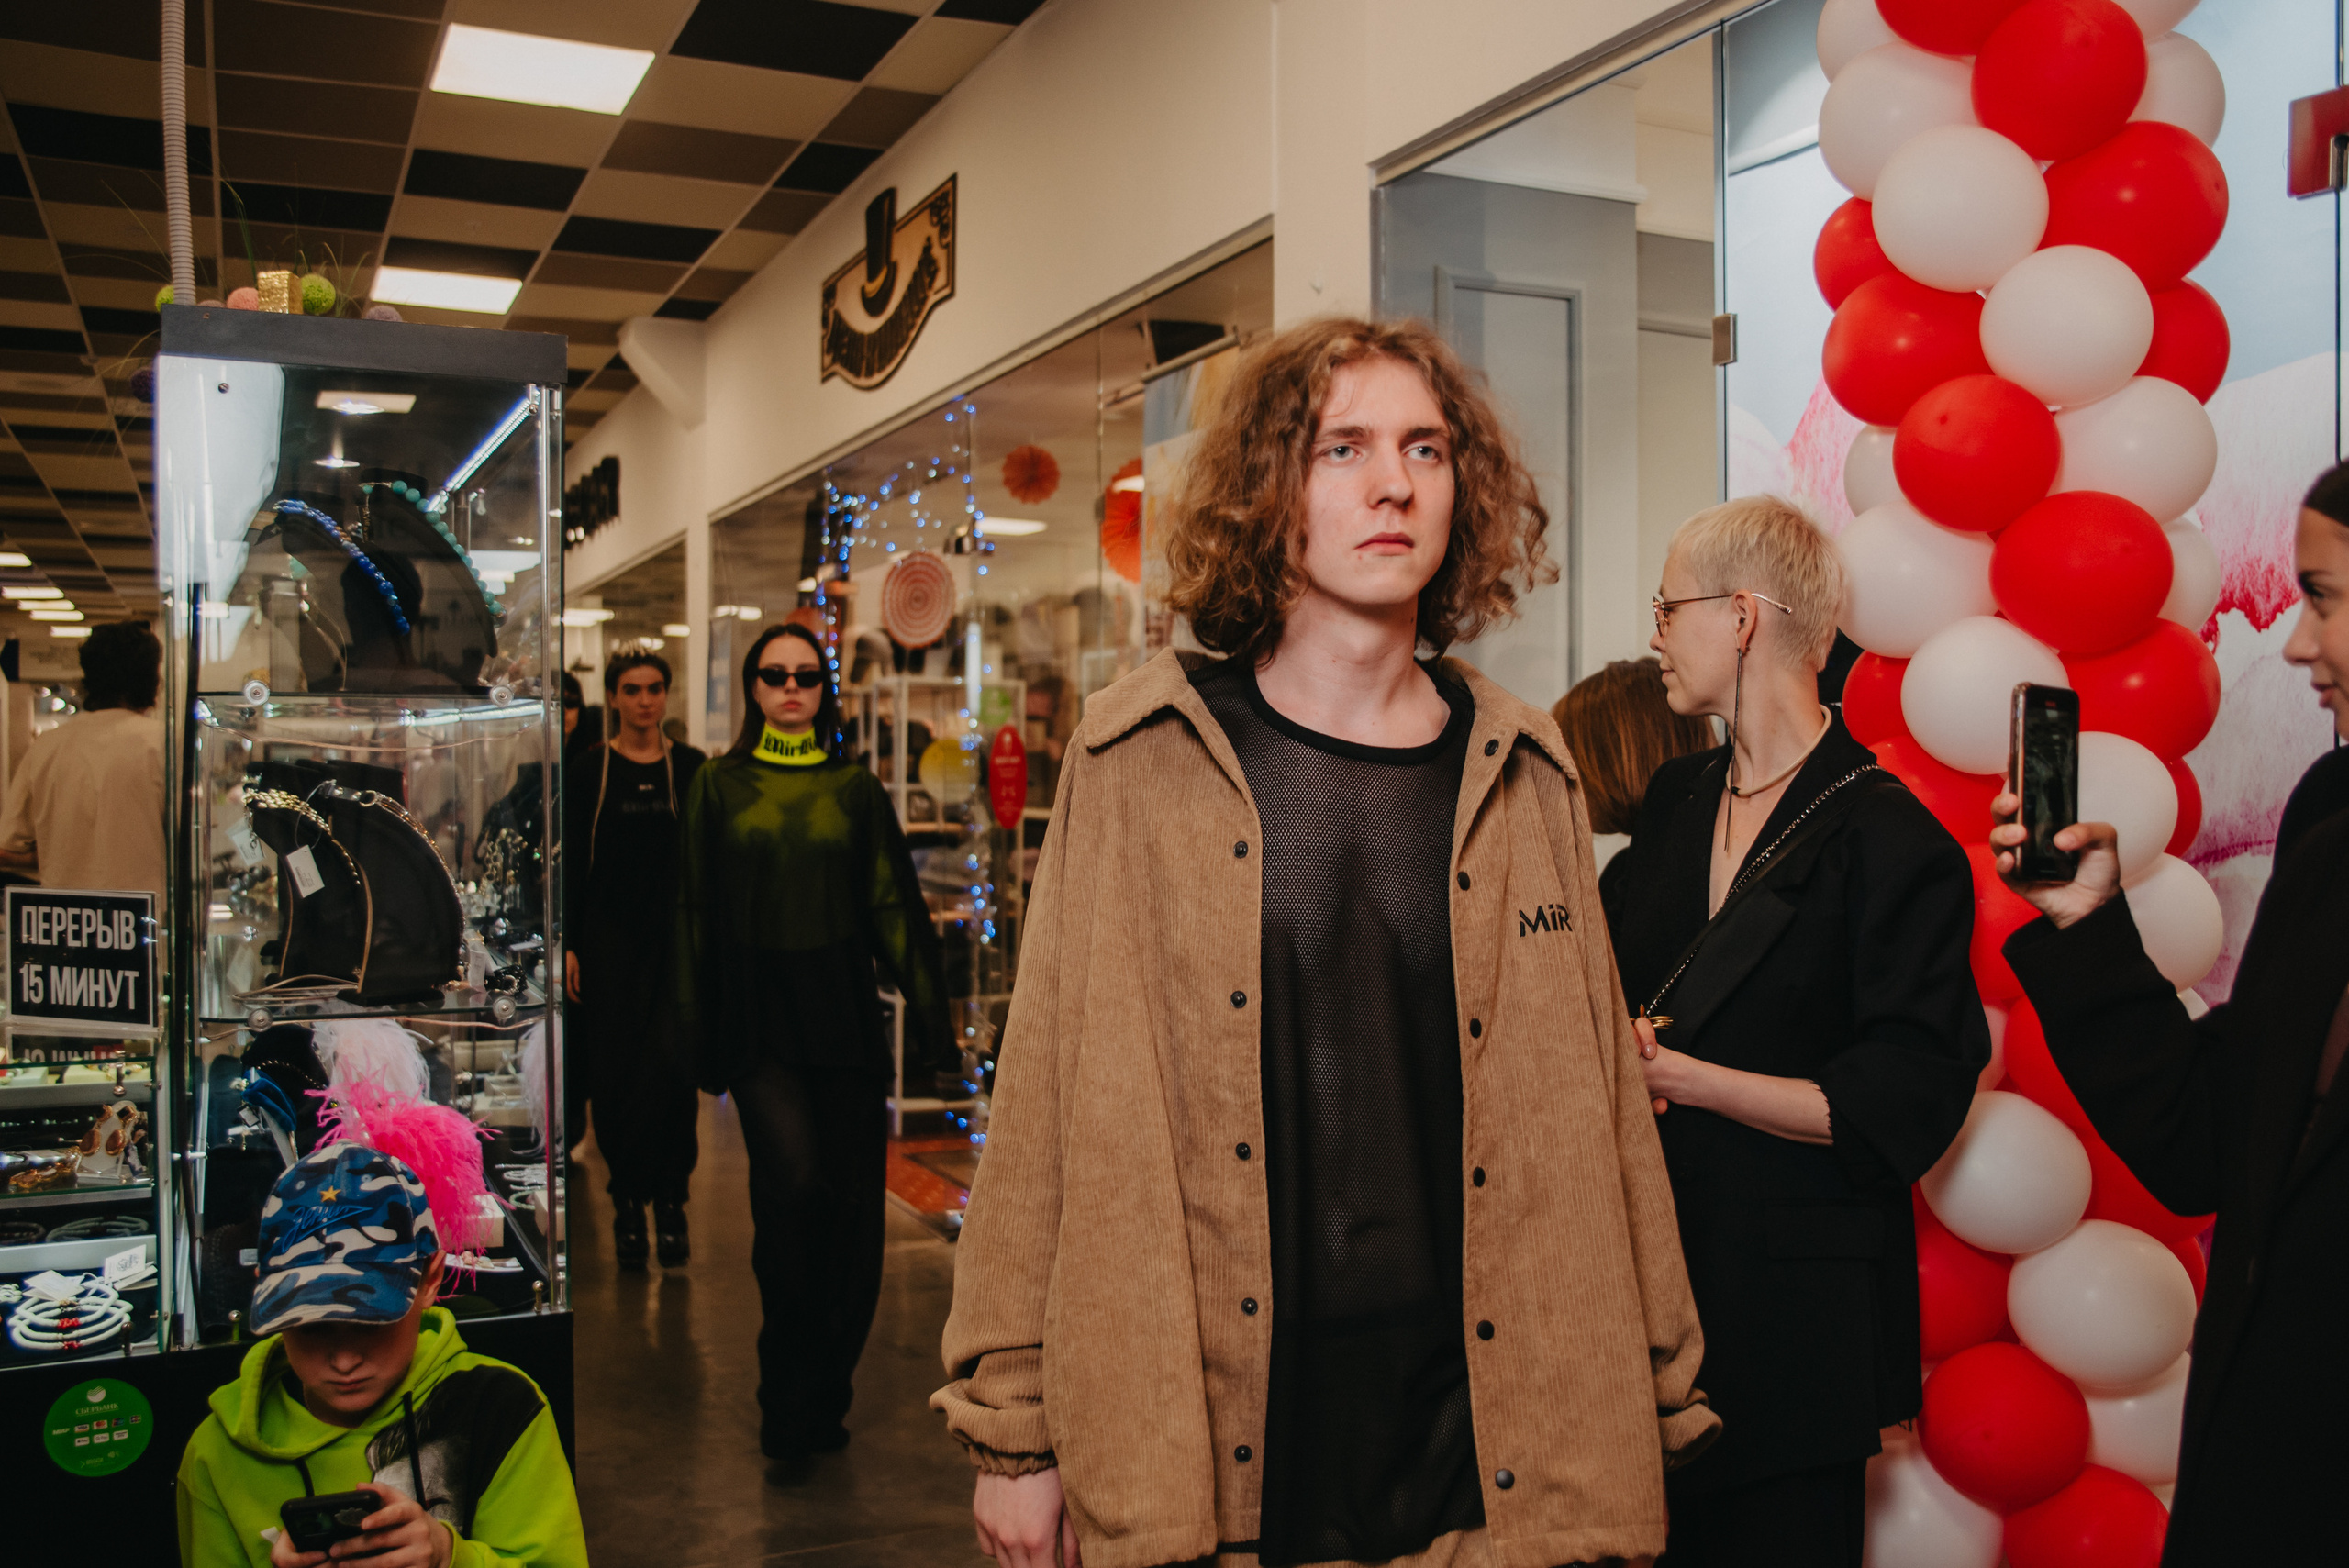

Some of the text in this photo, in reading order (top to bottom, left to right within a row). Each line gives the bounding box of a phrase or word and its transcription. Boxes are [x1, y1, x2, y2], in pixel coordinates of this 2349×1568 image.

[22, 906, 136, 950] ПЕРЕРЫВ
[19, 963, 139, 1009] 15 МИНУТ
